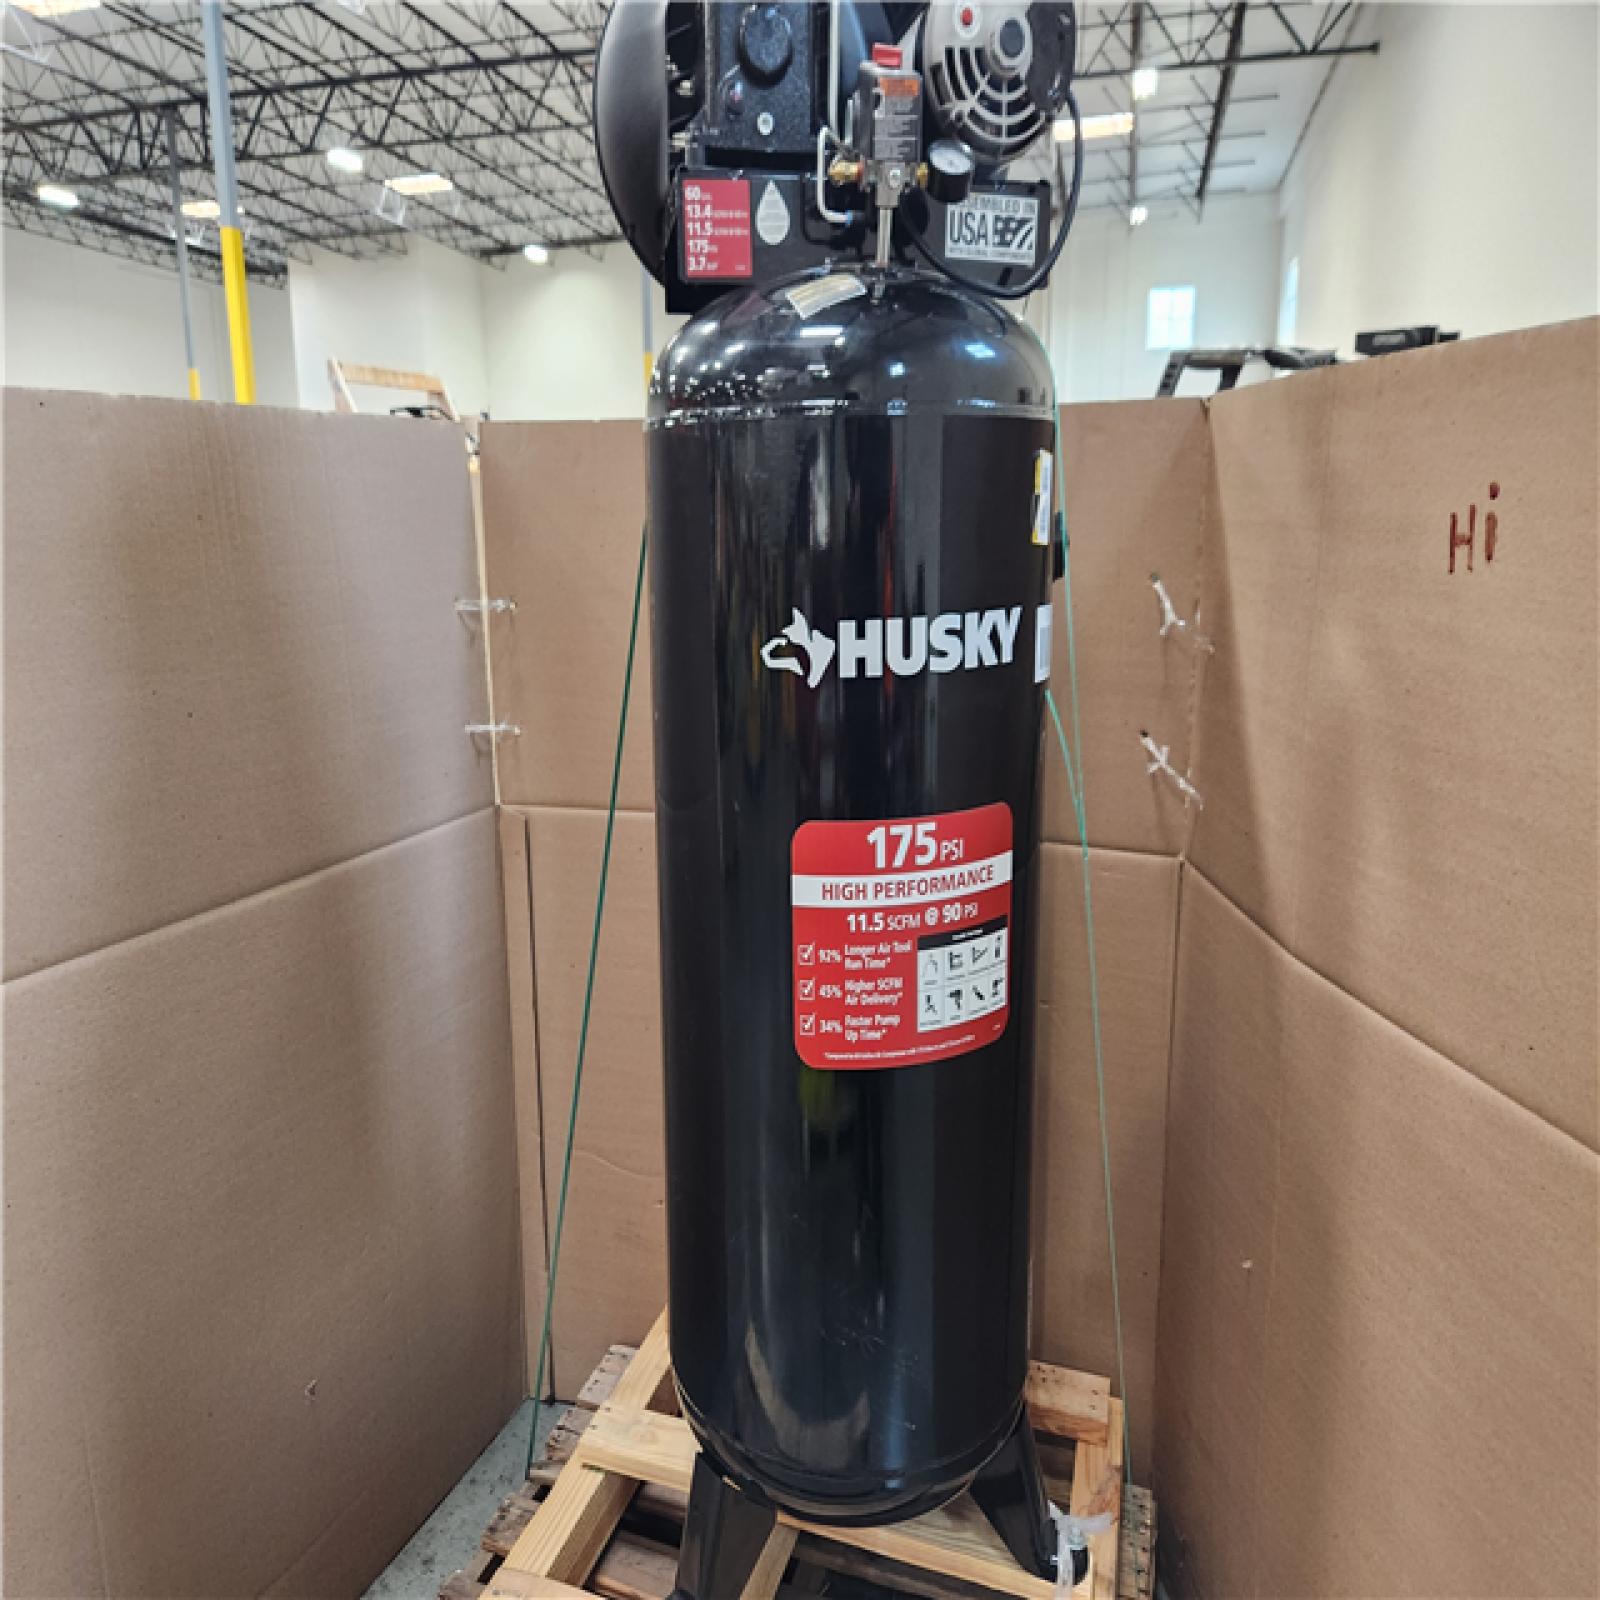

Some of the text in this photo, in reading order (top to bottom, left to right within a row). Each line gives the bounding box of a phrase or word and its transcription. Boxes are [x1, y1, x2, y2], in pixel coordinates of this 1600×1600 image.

[686, 204, 712, 218] 13.4
[687, 222, 713, 236] 11.5
[950, 210, 988, 247] USA
[837, 605, 1022, 679] HUSKY
[866, 821, 964, 869] 175 PSI
[822, 865, 994, 901] HIGH PERFORMANCE
[847, 911, 885, 933] 11.5
[887, 912, 921, 931] SCFM
[924, 906, 939, 926] @
[942, 901, 961, 923] 90
[844, 944, 876, 959] Longer
[877, 942, 892, 954] Air
[892, 939, 913, 953] Tool
[844, 977, 876, 993] Higher
[877, 976, 904, 991] SCFM
[844, 993, 858, 1006] Air
[874, 1014, 901, 1028] Pump
[844, 1029, 858, 1044] Up
